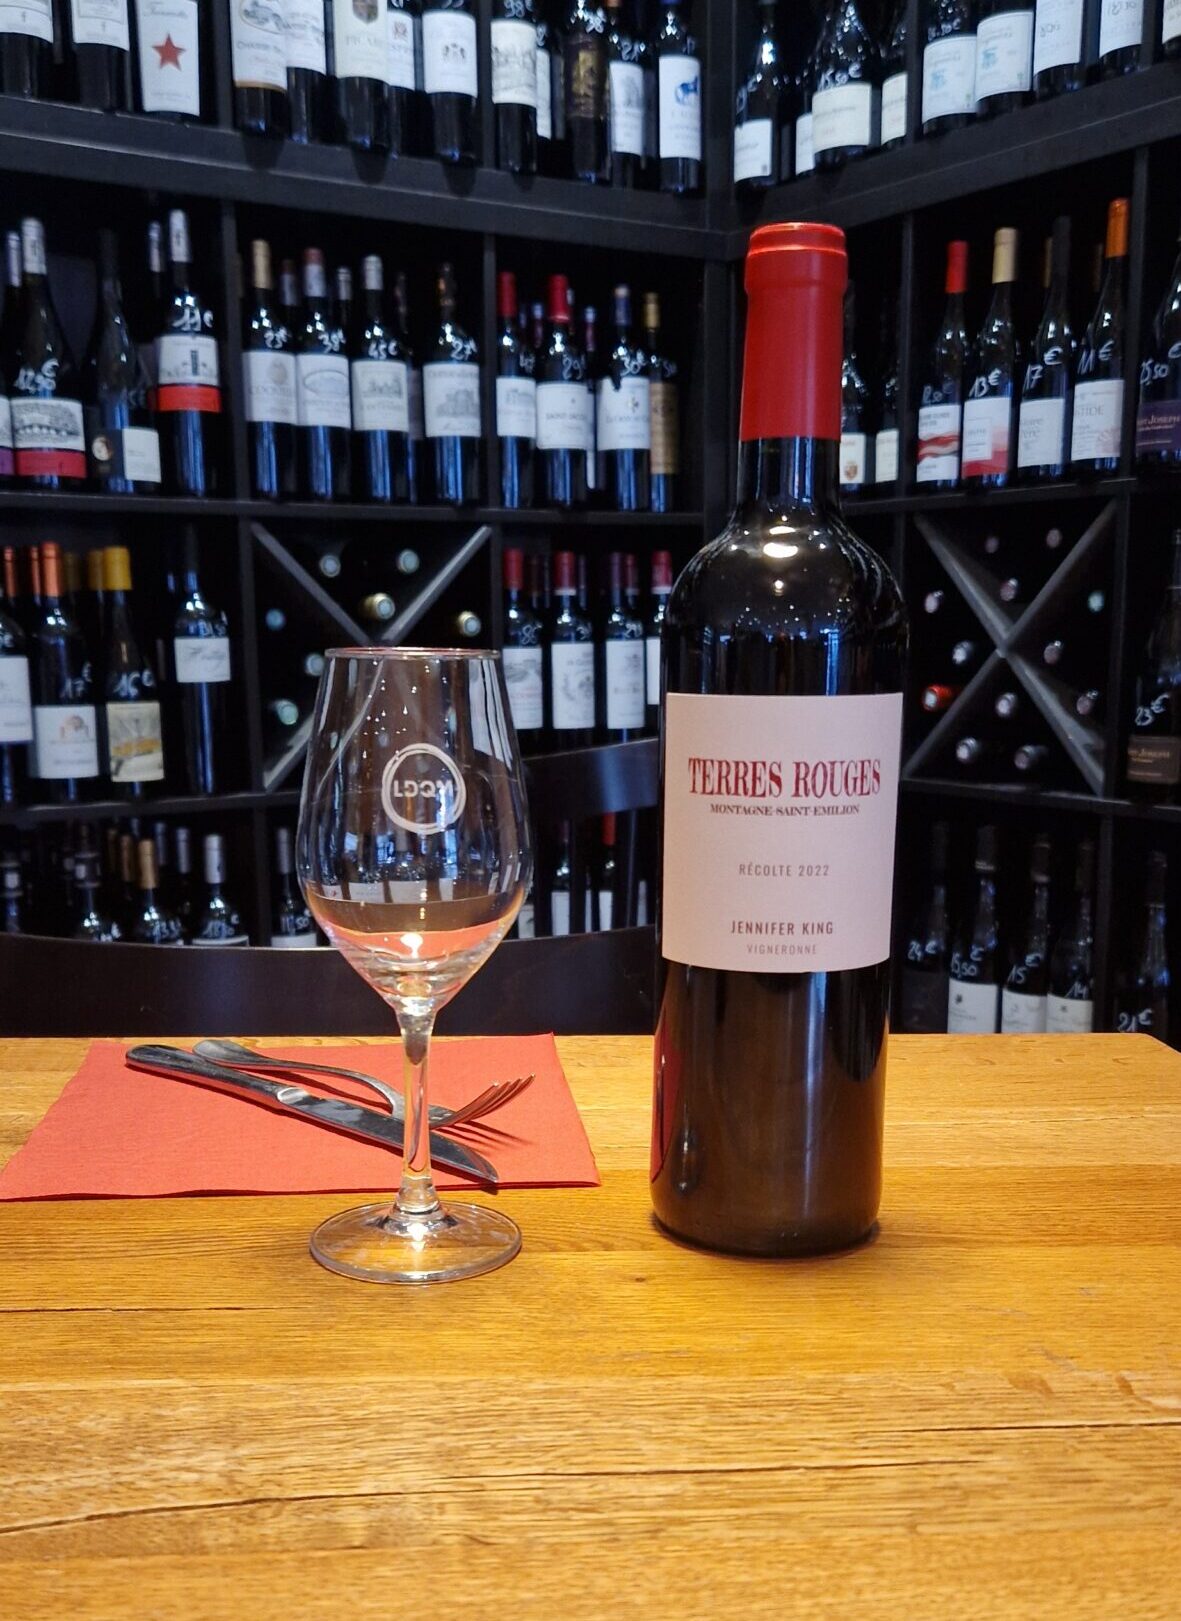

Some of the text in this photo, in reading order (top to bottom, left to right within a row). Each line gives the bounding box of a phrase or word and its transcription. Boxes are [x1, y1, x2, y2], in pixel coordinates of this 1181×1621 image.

[688, 757, 881, 799] TERRES ROUGES
[739, 862, 830, 877] RÉCOLTE 2022
[731, 920, 834, 936] JENNIFER KING
[747, 944, 817, 956] VIGNERONNE
